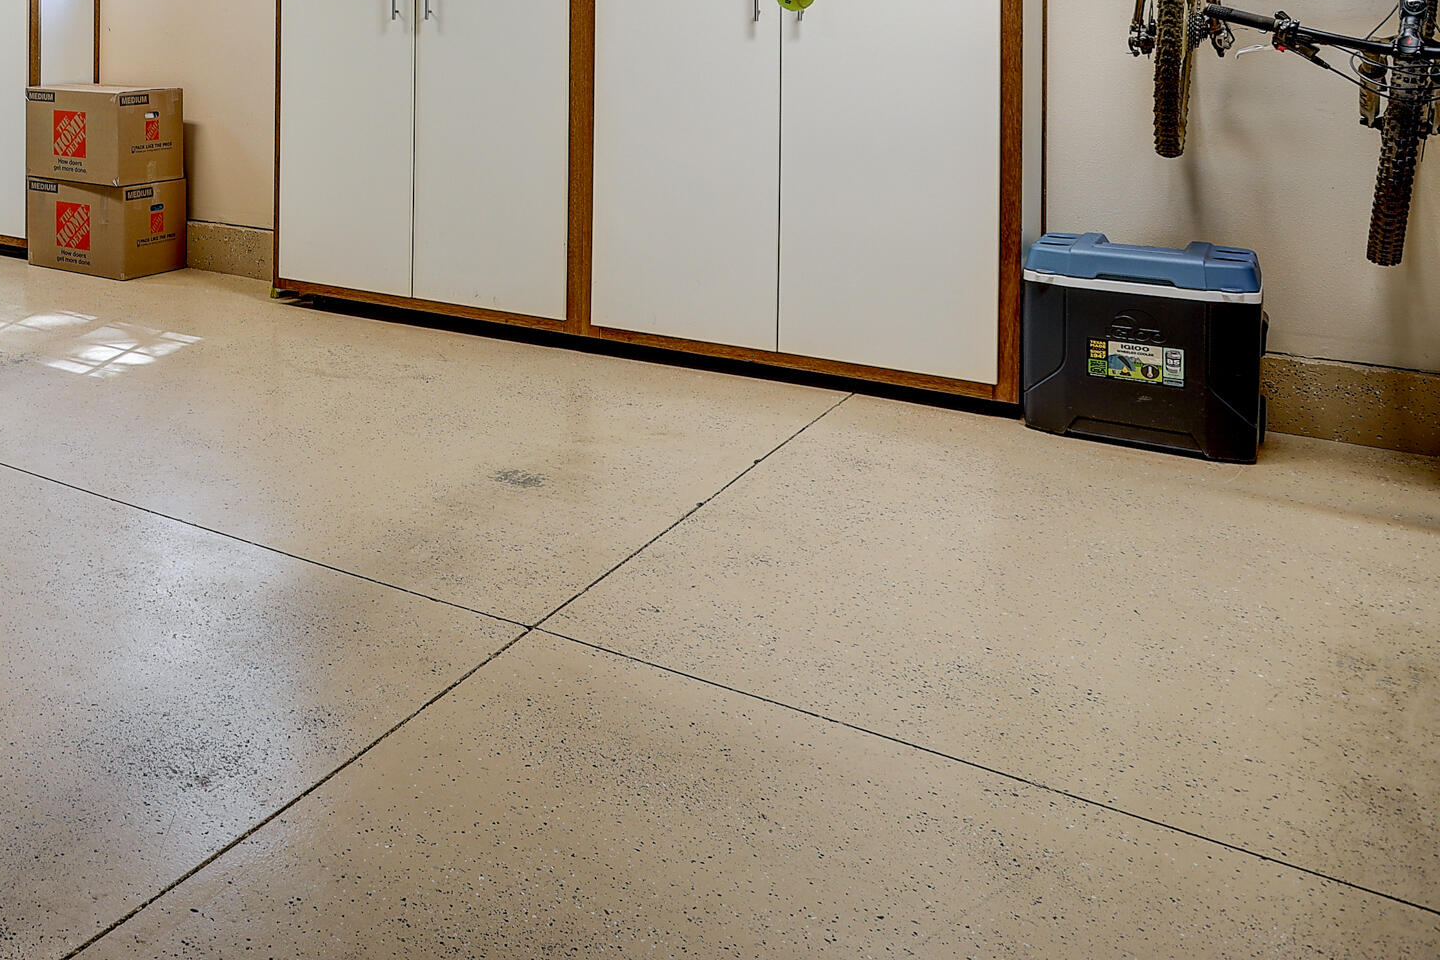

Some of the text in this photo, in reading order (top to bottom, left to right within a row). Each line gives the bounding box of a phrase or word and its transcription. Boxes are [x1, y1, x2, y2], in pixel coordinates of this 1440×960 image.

[29, 93, 53, 101] MEDIUM
[121, 96, 147, 104] MEDIUM
[56, 116, 70, 132] THE
[53, 112, 87, 156] HOME
[66, 129, 87, 156] DEPOT
[31, 182, 57, 192] MEDIUM
[128, 189, 152, 199] MEDIUM
[60, 208, 73, 224] THE
[56, 205, 90, 247] HOME
[69, 223, 90, 248] DEPOT
